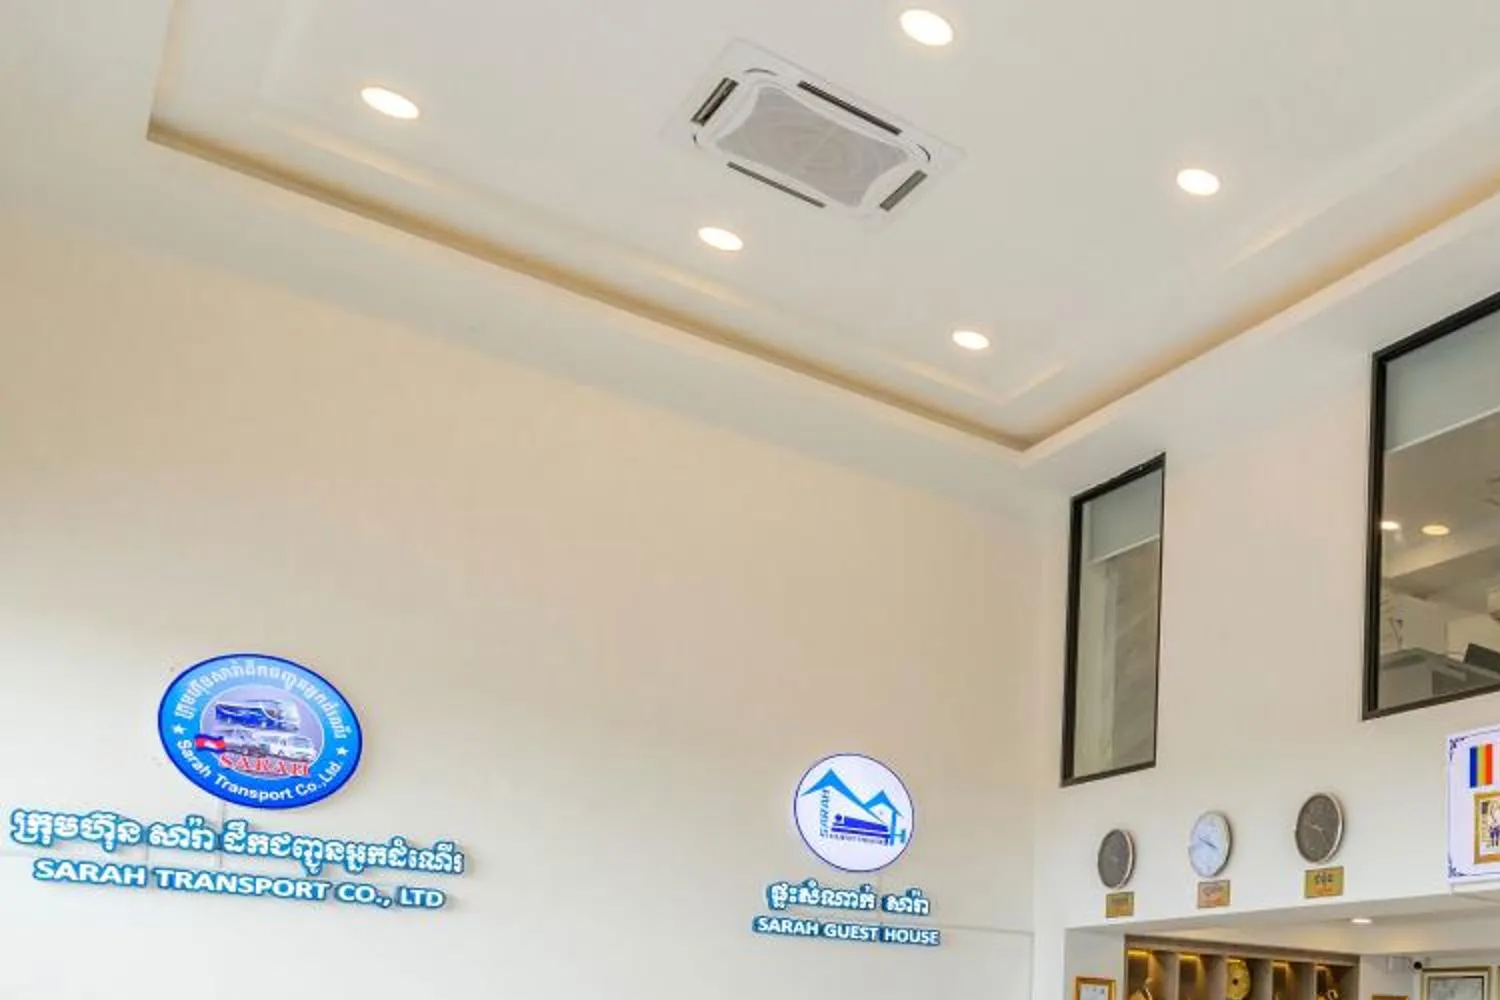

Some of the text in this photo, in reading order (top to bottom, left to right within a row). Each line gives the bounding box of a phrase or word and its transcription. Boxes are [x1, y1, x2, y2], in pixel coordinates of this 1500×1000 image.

[177, 739, 212, 778] Sarah
[214, 773, 294, 803] Transport
[219, 753, 310, 777] SARAH
[818, 788, 831, 838] SARAH
[34, 859, 446, 909] SARAH TRANSPORT CO., LTD
[757, 917, 940, 945] SARAH GUEST HOUSE
